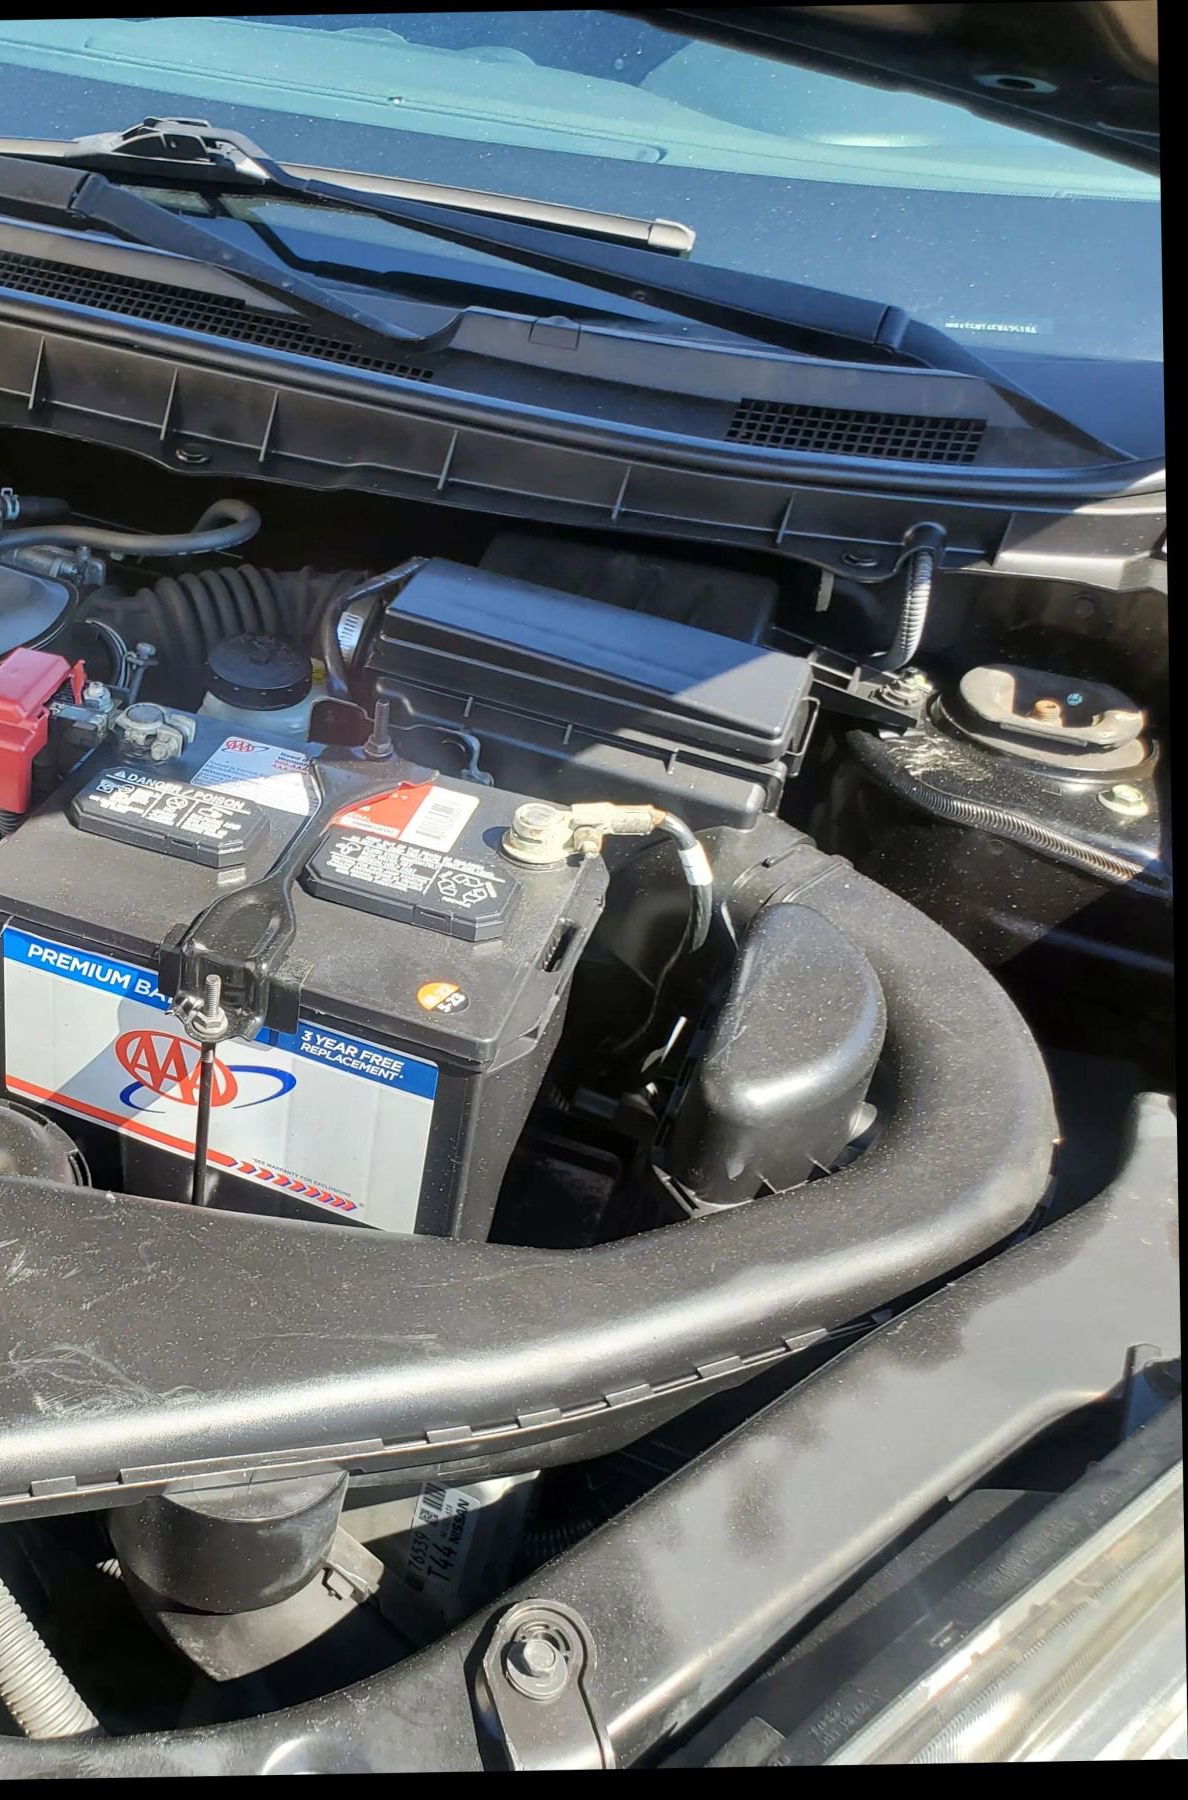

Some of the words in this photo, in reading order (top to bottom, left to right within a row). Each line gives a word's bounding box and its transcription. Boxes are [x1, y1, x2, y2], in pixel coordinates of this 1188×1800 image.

[226, 739, 253, 753] AAA
[127, 773, 182, 795] DANGER
[193, 791, 245, 811] POISON
[26, 943, 132, 989] PREMIUM
[116, 1031, 237, 1107] AAA
[300, 1030, 314, 1042] 3
[315, 1033, 358, 1057] YEAR
[359, 1049, 405, 1073] FREE
[266, 1162, 299, 1179] WARRANTY
[299, 1174, 313, 1184] FOR
[313, 1180, 352, 1198] EXCLUSIONS
[448, 1498, 470, 1546] NISSAN
[408, 1530, 430, 1572] 76539
[426, 1541, 457, 1582] T44
